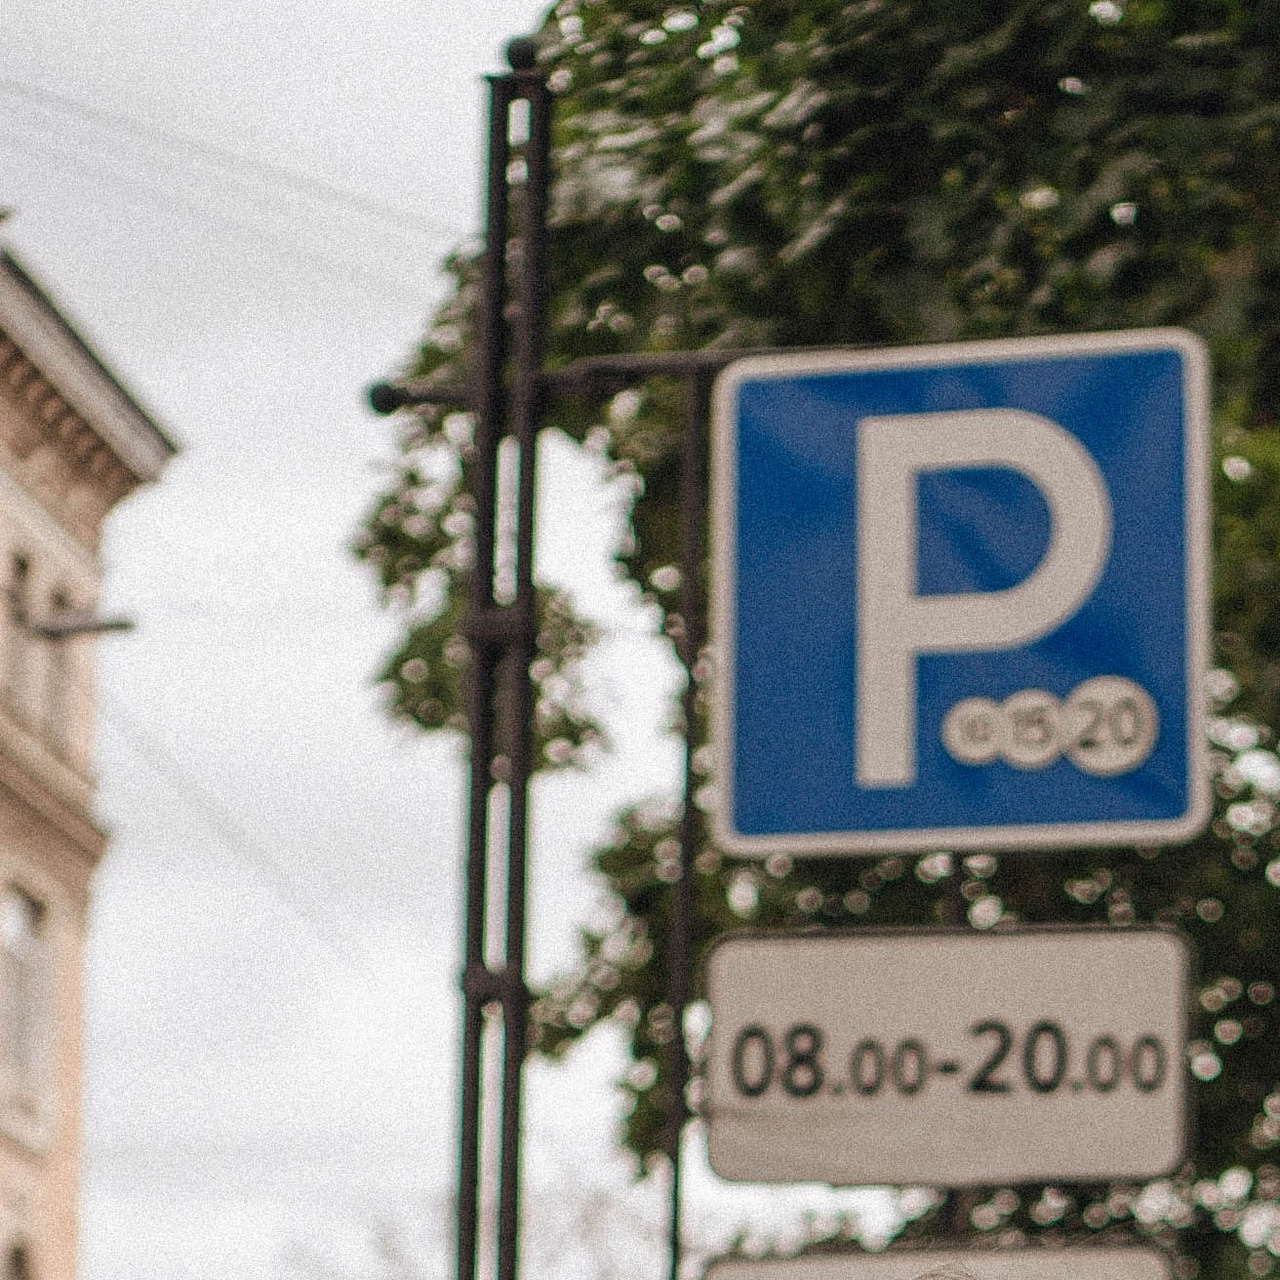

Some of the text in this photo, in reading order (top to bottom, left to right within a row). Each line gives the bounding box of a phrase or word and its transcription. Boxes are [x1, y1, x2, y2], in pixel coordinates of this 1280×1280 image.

[857, 408, 1113, 787] P
[1077, 698, 1143, 749] 20
[731, 1018, 1168, 1098] 08.00-20.00
